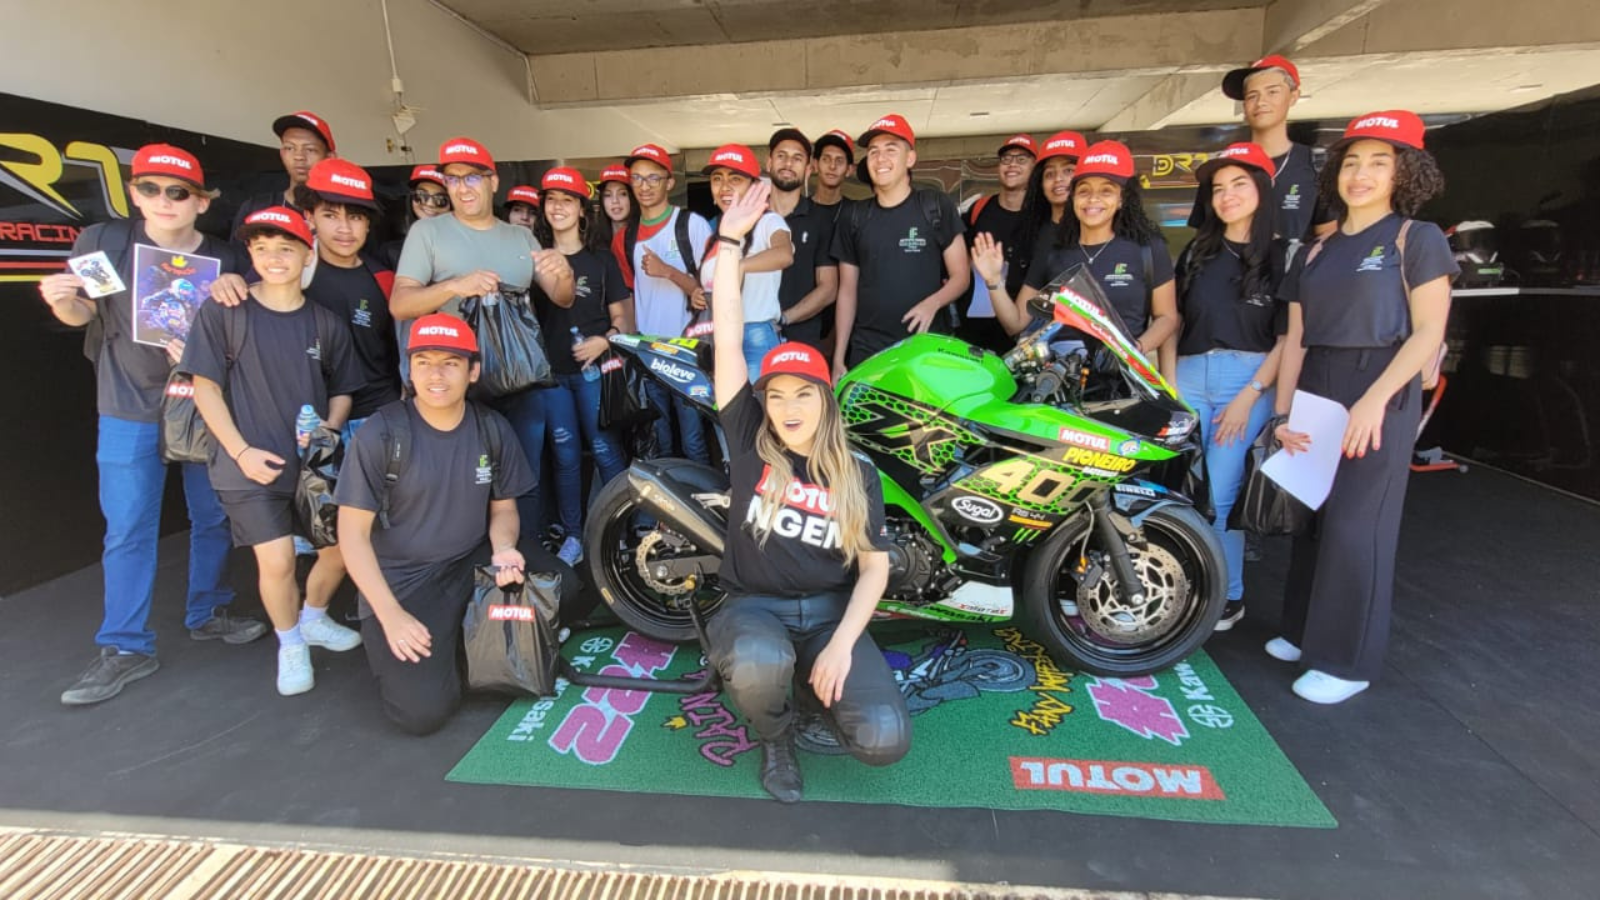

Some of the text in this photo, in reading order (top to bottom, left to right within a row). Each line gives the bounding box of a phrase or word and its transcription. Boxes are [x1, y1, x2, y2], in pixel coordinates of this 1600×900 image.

[1354, 117, 1399, 130] MOTUL
[445, 144, 478, 155] MOTUL
[1046, 139, 1075, 151] MOTUL
[148, 154, 192, 170] MOTUL
[715, 151, 743, 163] MOTUL
[1083, 153, 1119, 166] MOTUL
[331, 174, 368, 190] MOTUL
[547, 172, 574, 184] MOTUL
[250, 211, 292, 224] MOTUL
[418, 326, 459, 337] MOTUL
[771, 351, 811, 366] MOTUL
[651, 358, 697, 383] bioleve
[1061, 429, 1107, 450] MOTUL
[1062, 446, 1138, 473] PIONEIRO
[491, 606, 533, 619] MOTUL
[1020, 761, 1203, 794] MOTUL
